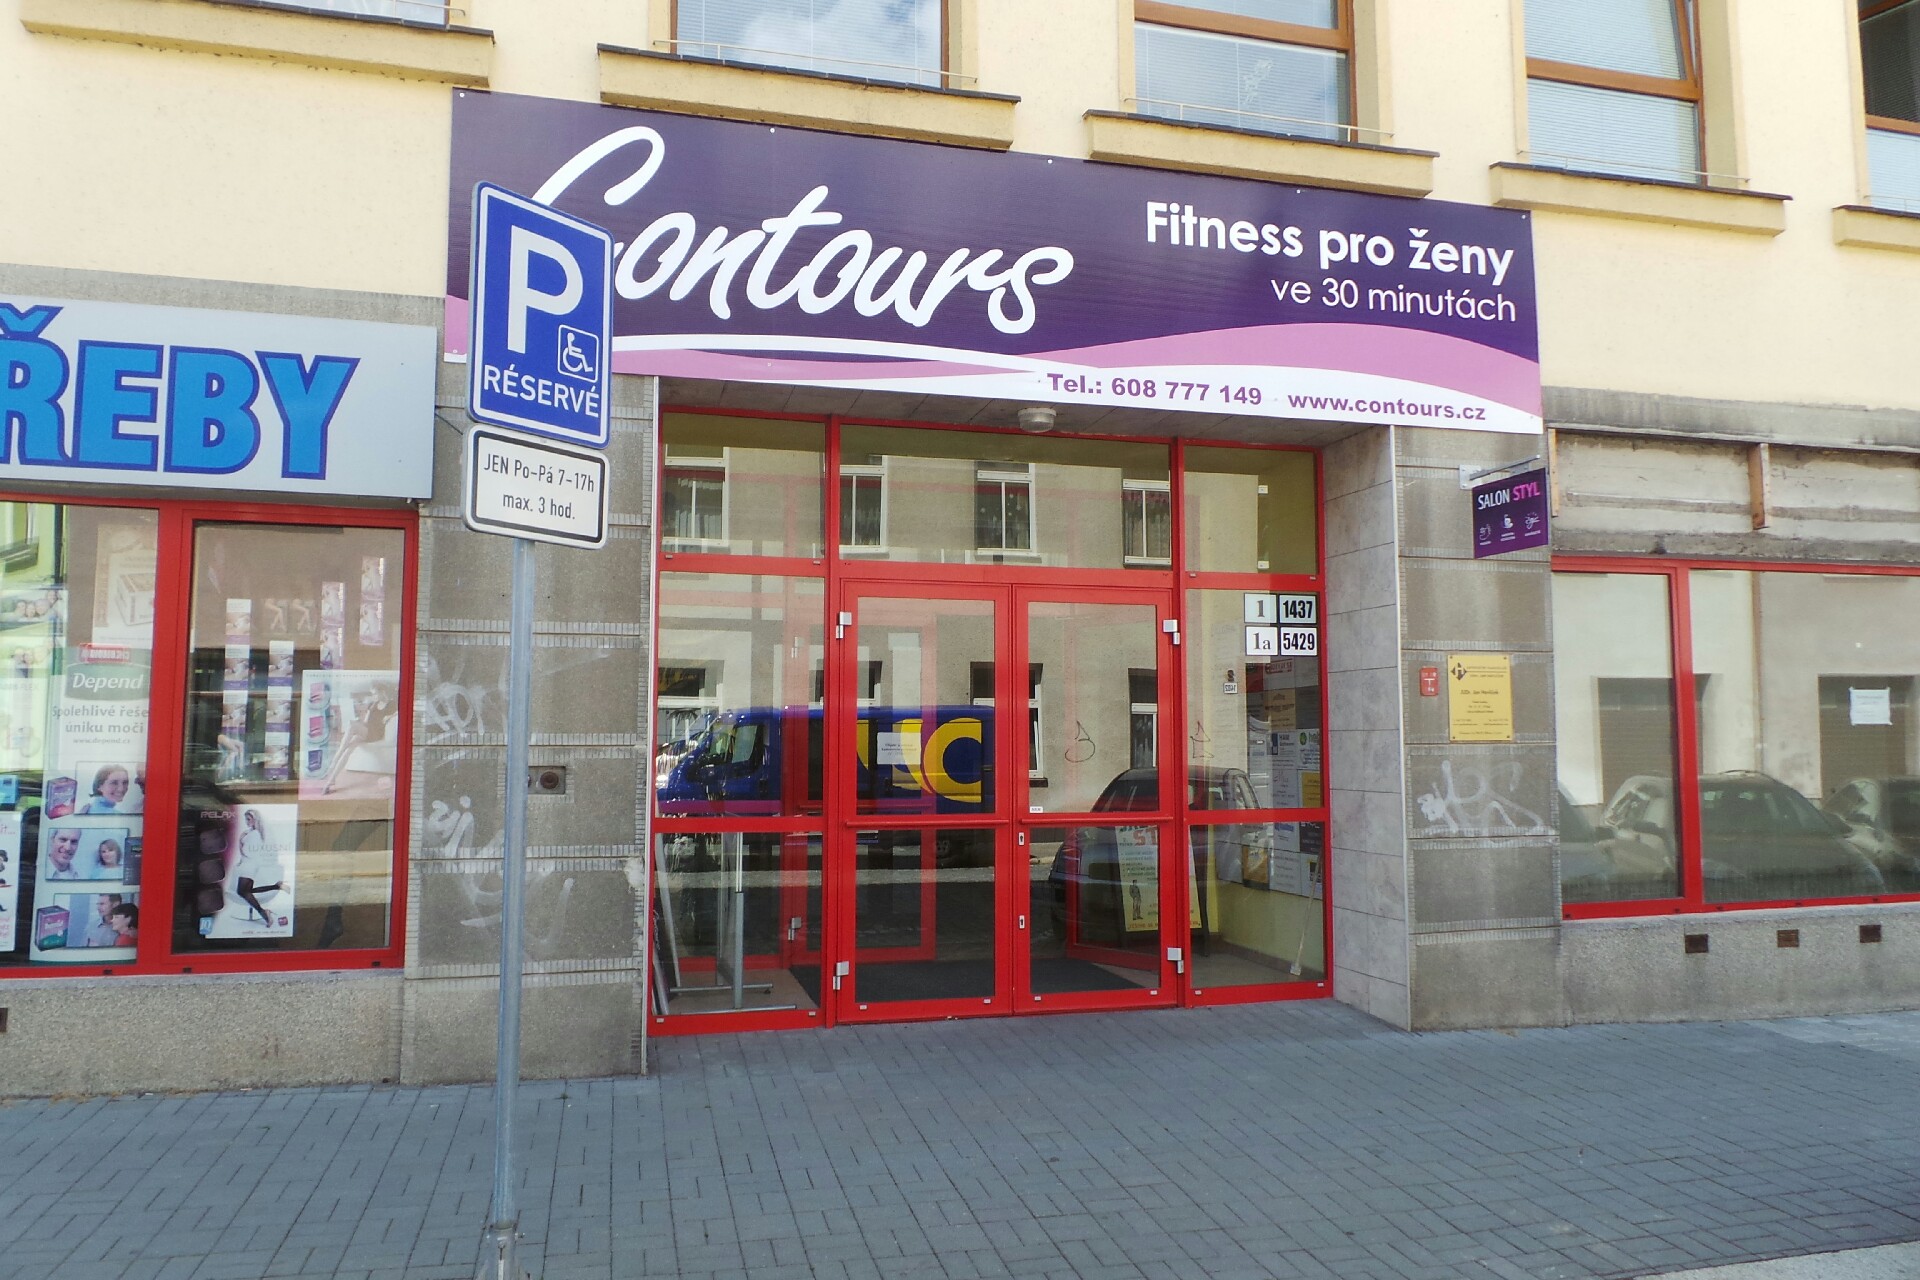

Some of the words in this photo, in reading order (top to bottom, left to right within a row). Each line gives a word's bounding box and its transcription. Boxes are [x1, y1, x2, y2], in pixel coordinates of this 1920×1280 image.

[1146, 201, 1303, 258] Fitness
[1319, 227, 1395, 269] pro
[1408, 228, 1514, 285] ženy
[508, 225, 584, 354] P
[1271, 277, 1311, 304] ve
[1322, 278, 1358, 309] 30
[1369, 285, 1516, 322] minutách
[484, 363, 600, 418] RÉSERVÉ
[1047, 372, 1103, 394] Tel.:
[1111, 377, 1156, 399] 608
[1165, 381, 1210, 402] 777
[1219, 384, 1262, 406] 149
[1288, 392, 1486, 421] www.contours.cz
[484, 453, 508, 475] JEN
[514, 457, 553, 484] Po-Pá
[559, 468, 594, 493] 7-17h
[503, 494, 533, 512] max.
[538, 494, 545, 513] 3
[550, 495, 576, 520] hod.
[1478, 488, 1510, 510] SALON
[1513, 482, 1540, 501] STYL
[1256, 599, 1265, 617] 1
[1282, 600, 1313, 619] 1437
[1253, 632, 1270, 650] 1a
[1283, 632, 1315, 651] 5429
[72, 673, 144, 693] Depend
[52, 705, 116, 719] Spolehlivé
[66, 721, 103, 733] úniku
[108, 722, 144, 734] moči
[200, 811, 236, 819] RELAX
